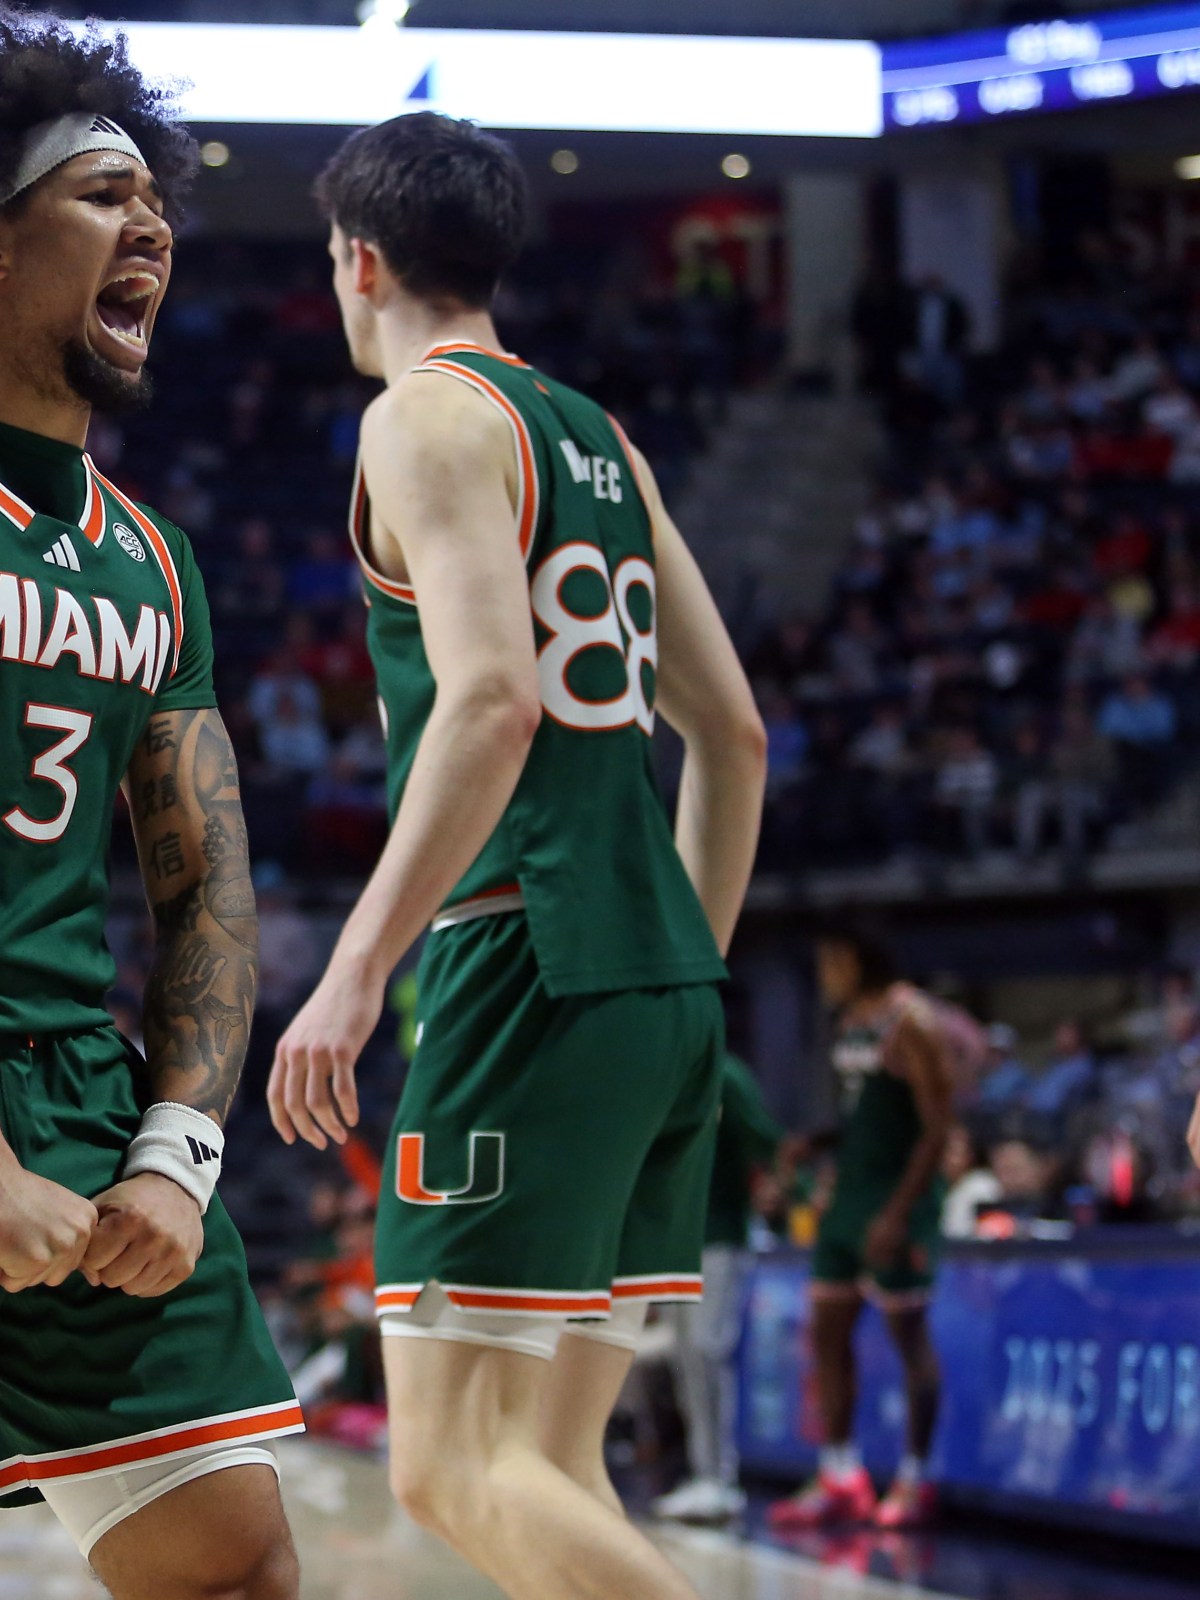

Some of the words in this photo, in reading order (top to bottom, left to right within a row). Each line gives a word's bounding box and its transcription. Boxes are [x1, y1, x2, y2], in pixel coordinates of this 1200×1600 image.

[530, 540, 657, 738] 88
[1, 701, 94, 843] 3
[395, 1130, 505, 1206] U
